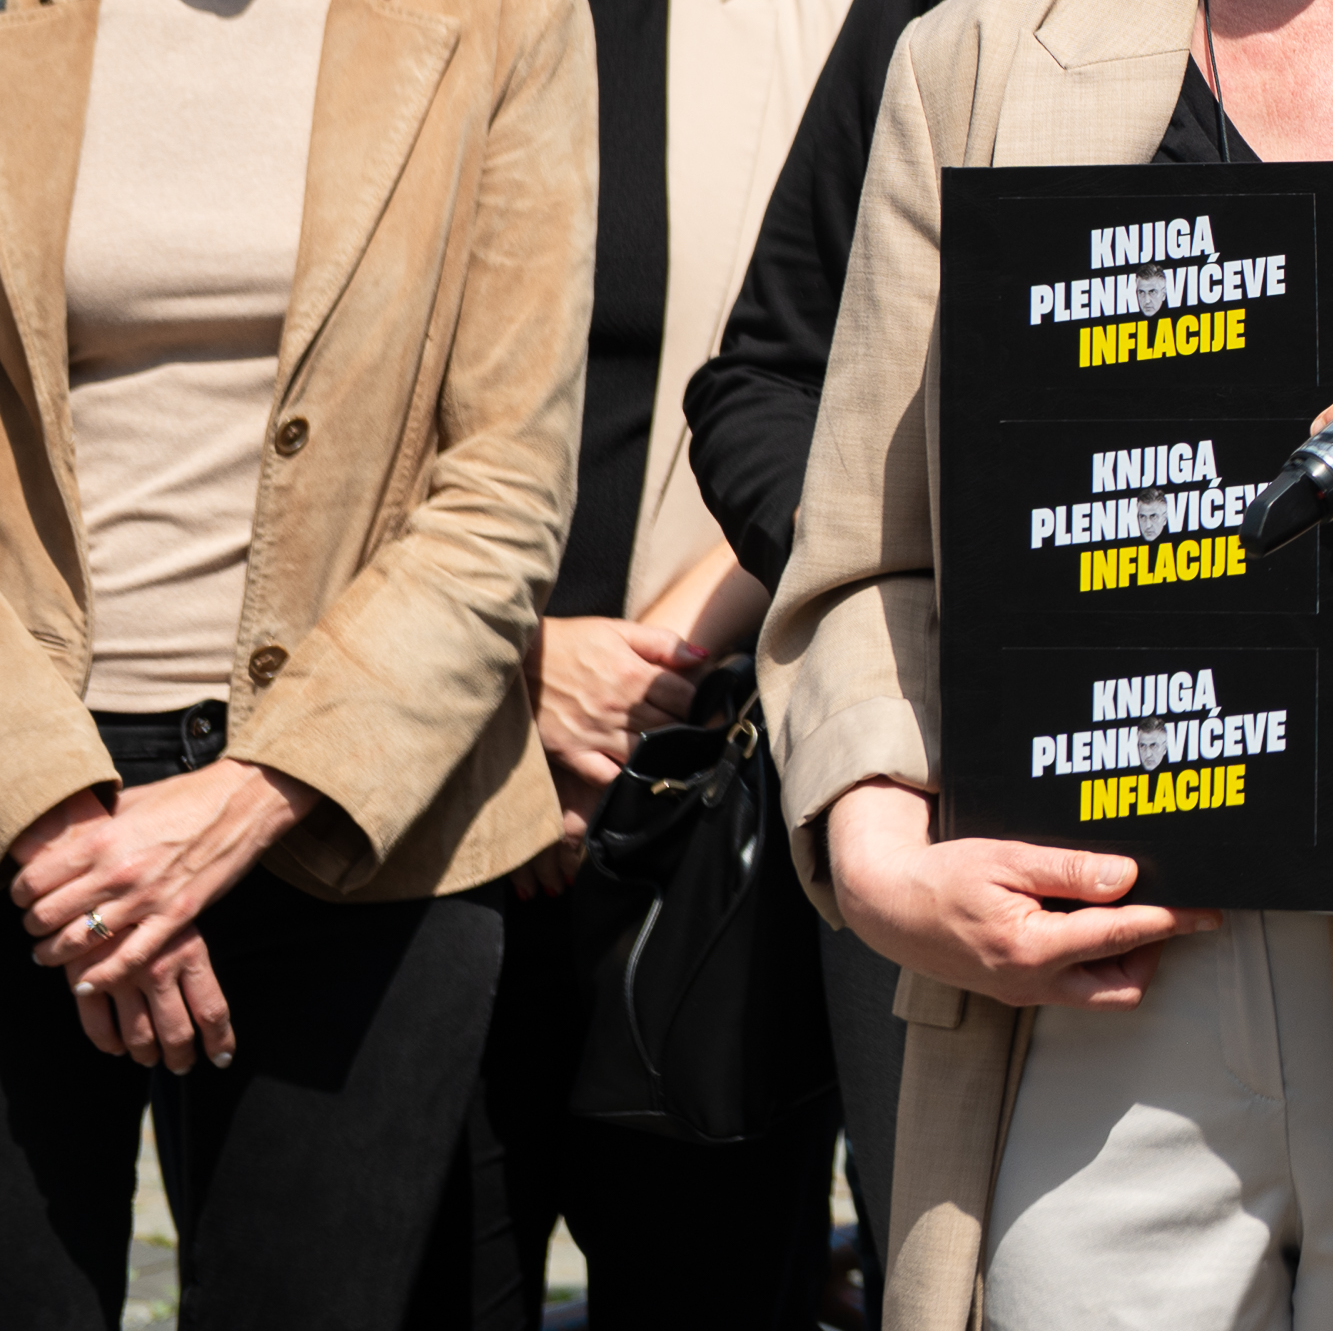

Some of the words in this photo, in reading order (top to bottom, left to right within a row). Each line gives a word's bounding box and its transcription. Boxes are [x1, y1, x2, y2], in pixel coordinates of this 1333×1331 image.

[1090, 215, 1215, 270] KNJIGA
[1030, 253, 1286, 326] PLENKVIĆEVE
[1079, 308, 1246, 368] INFLACIJE
[1092, 440, 1218, 494] KNJIGA
[1031, 477, 1273, 550] PLENKVIĆE
[1079, 534, 1247, 593] INFLACIJE
[1092, 668, 1218, 723] KNJIGA
[1031, 706, 1287, 778] PLENKVIĆEVE
[1079, 763, 1246, 822] INFLACIJE
